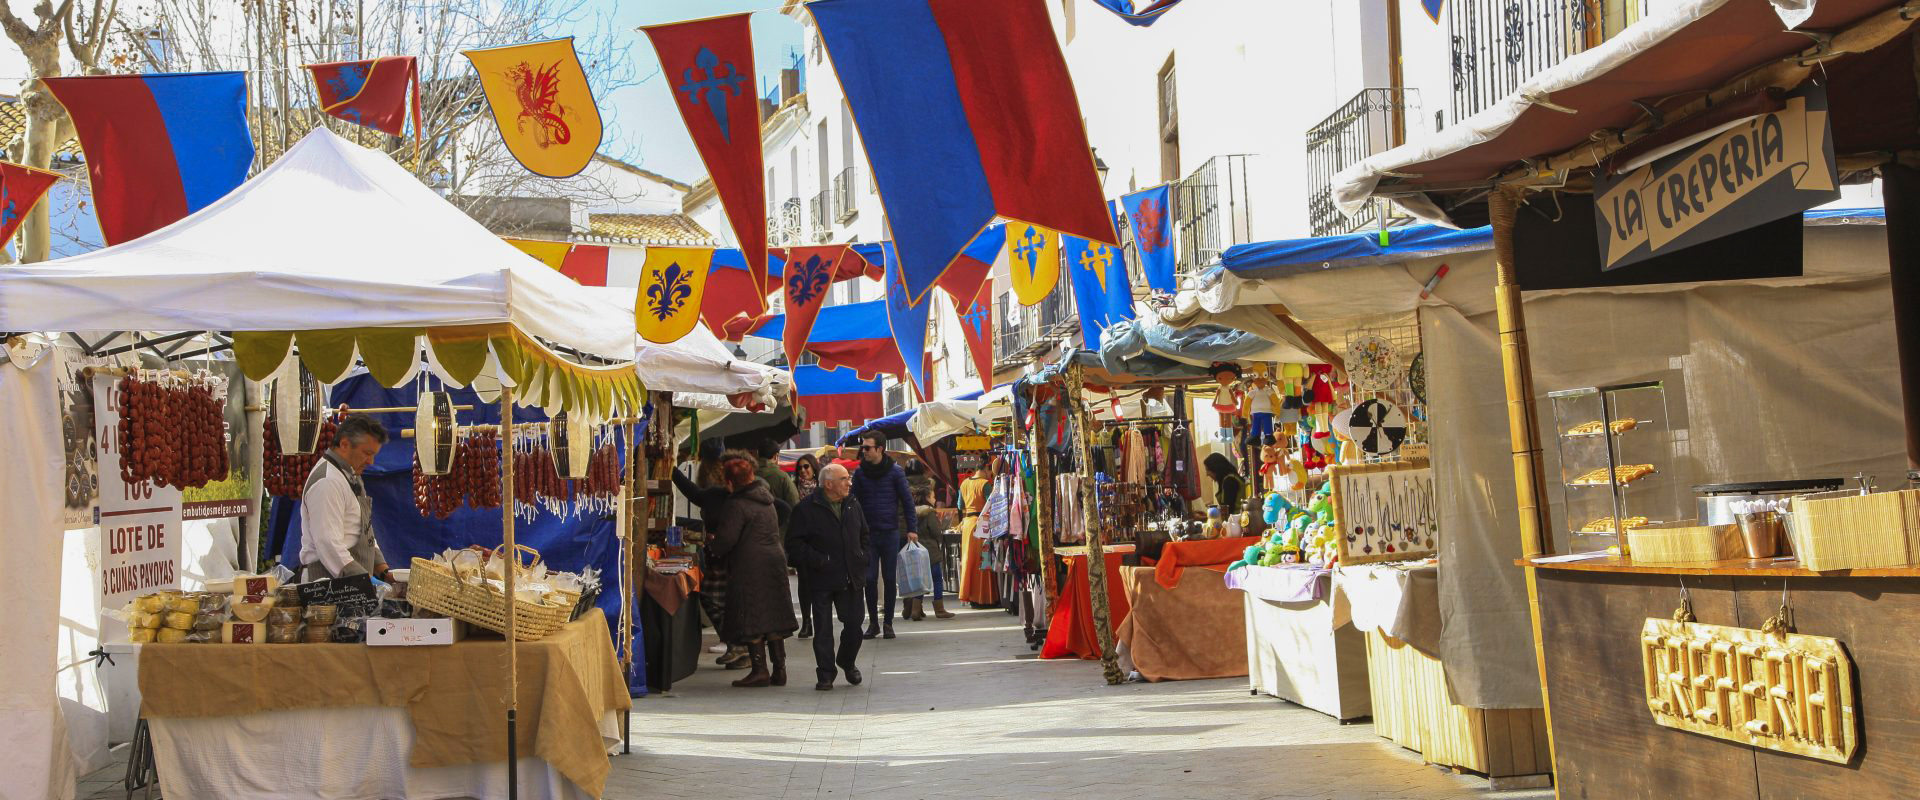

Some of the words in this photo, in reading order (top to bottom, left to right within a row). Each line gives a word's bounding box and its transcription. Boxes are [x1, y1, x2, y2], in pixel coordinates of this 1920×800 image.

[1613, 188, 1643, 241] LA
[1656, 113, 1784, 229] CREPERÍA
[101, 425, 110, 455] 4
[182, 503, 249, 518] embutidosmelgar.com
[109, 526, 143, 555] LOTE
[147, 523, 165, 549] DE
[103, 569, 108, 596] 3
[110, 561, 138, 594] CUÑAS
[140, 559, 174, 589] PAYOYAS
[1641, 634, 1846, 756] CREPERIA
